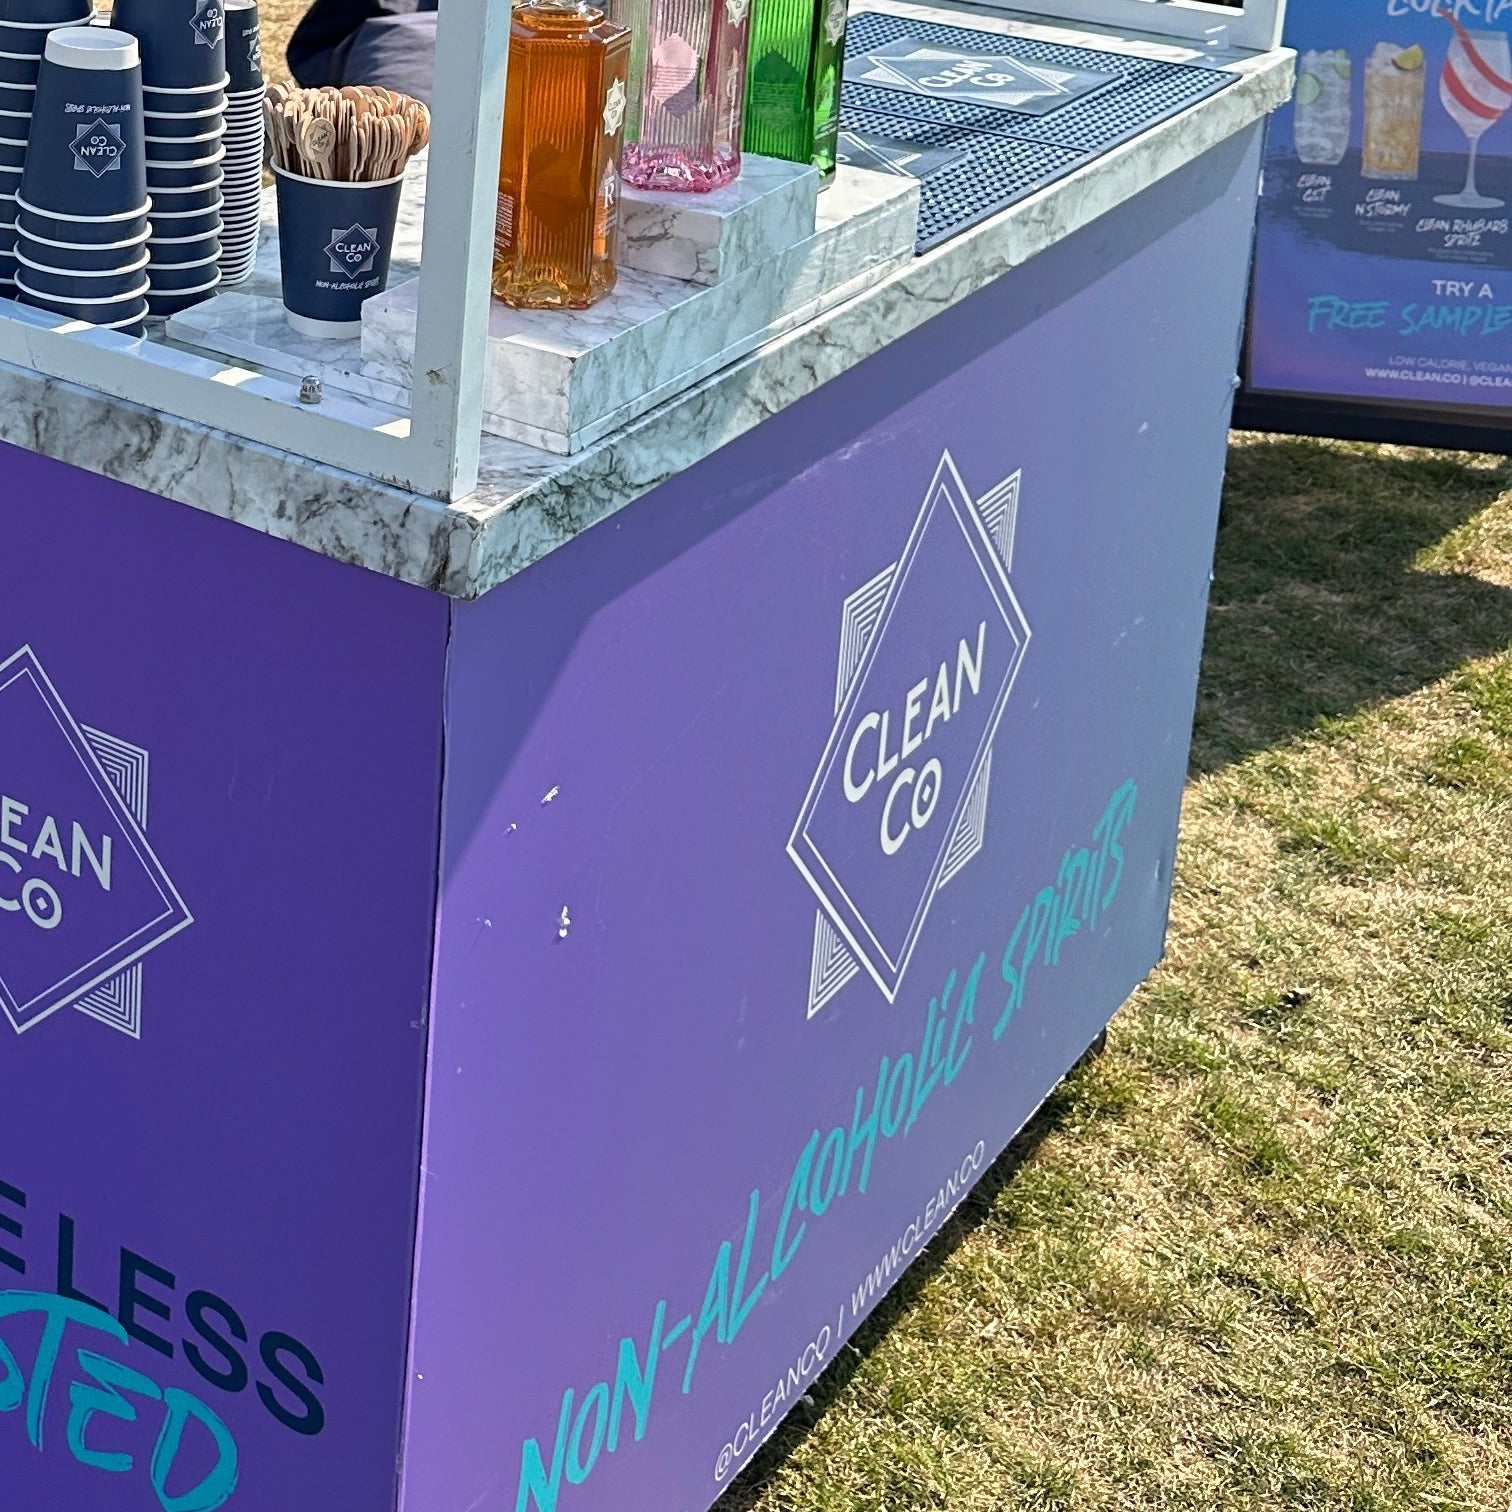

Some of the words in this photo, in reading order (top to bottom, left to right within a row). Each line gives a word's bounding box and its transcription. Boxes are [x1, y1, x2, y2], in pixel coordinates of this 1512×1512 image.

[917, 59, 994, 88] CLEAN
[80, 145, 117, 157] CLEAN
[335, 241, 371, 253] CLEAN
[1431, 279, 1474, 297] TRY
[1478, 283, 1494, 299] A
[1307, 295, 1391, 334] FREE
[1365, 367, 1461, 385] WWW.CLEAN.CO
[843, 620, 986, 803] CLEAN
[880, 758, 942, 855] CO
[58, 1213, 325, 1436] LESS
[714, 1325, 831, 1482] @CLEANCO
[851, 1140, 985, 1316] WWW.CLEAN.CO
